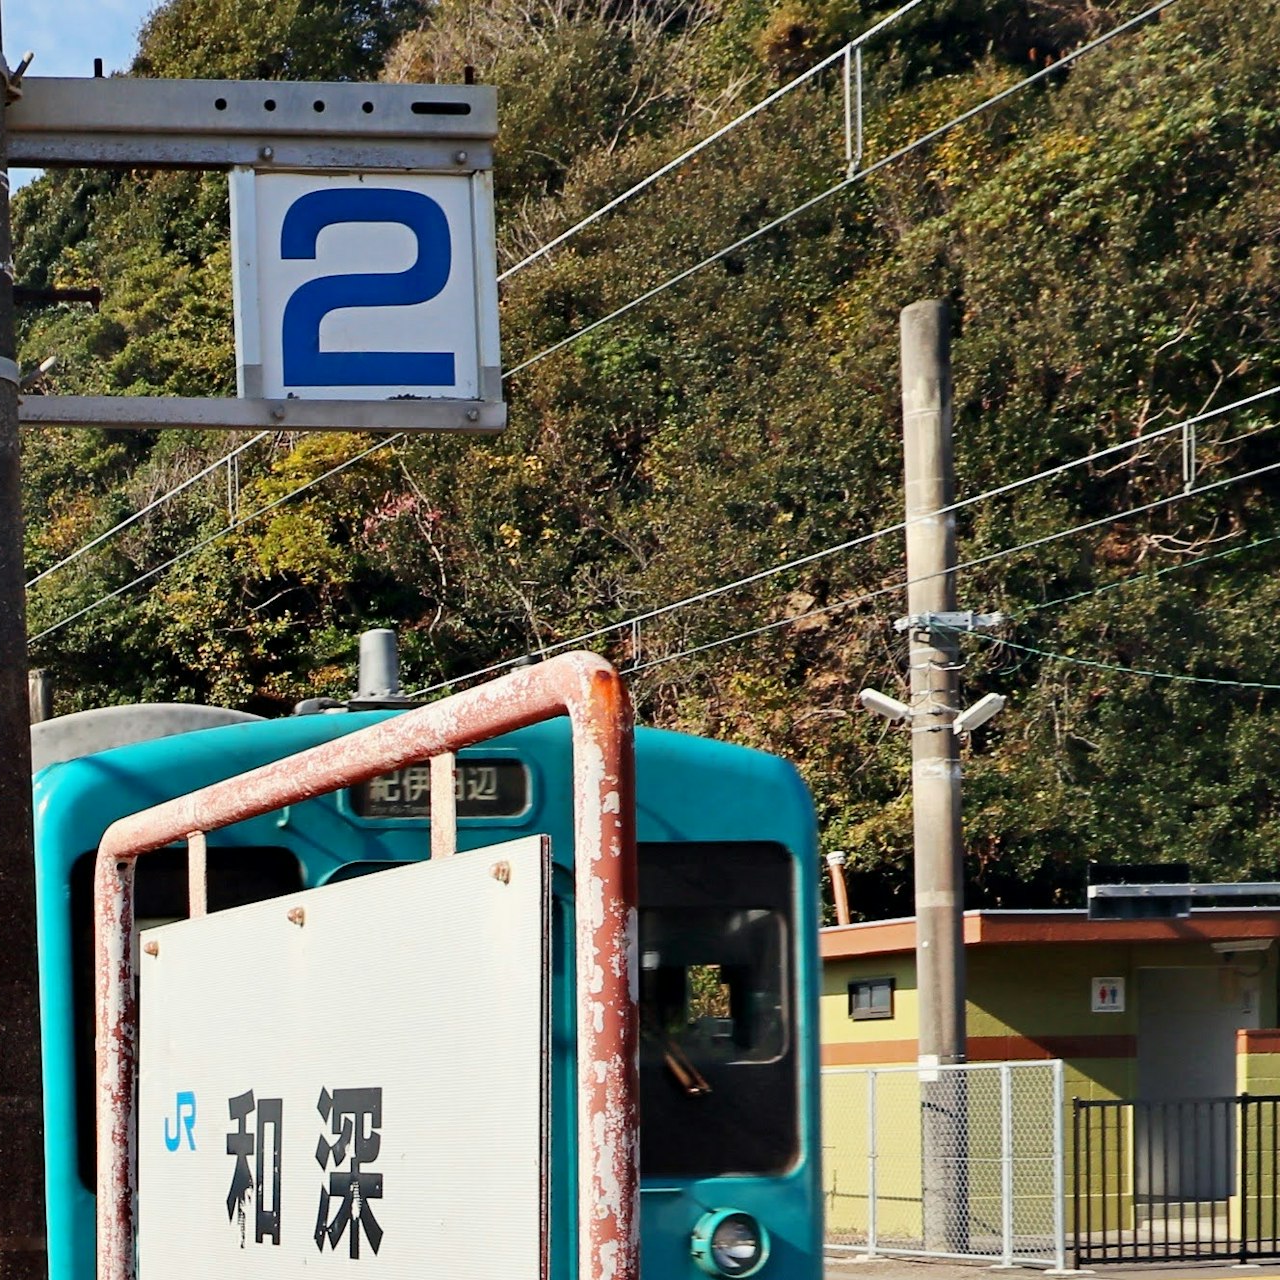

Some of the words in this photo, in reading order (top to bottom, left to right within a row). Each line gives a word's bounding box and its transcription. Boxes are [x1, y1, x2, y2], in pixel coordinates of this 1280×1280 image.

[280, 187, 456, 387] 2
[164, 1091, 197, 1152] JR
[225, 1086, 384, 1260] 和深
